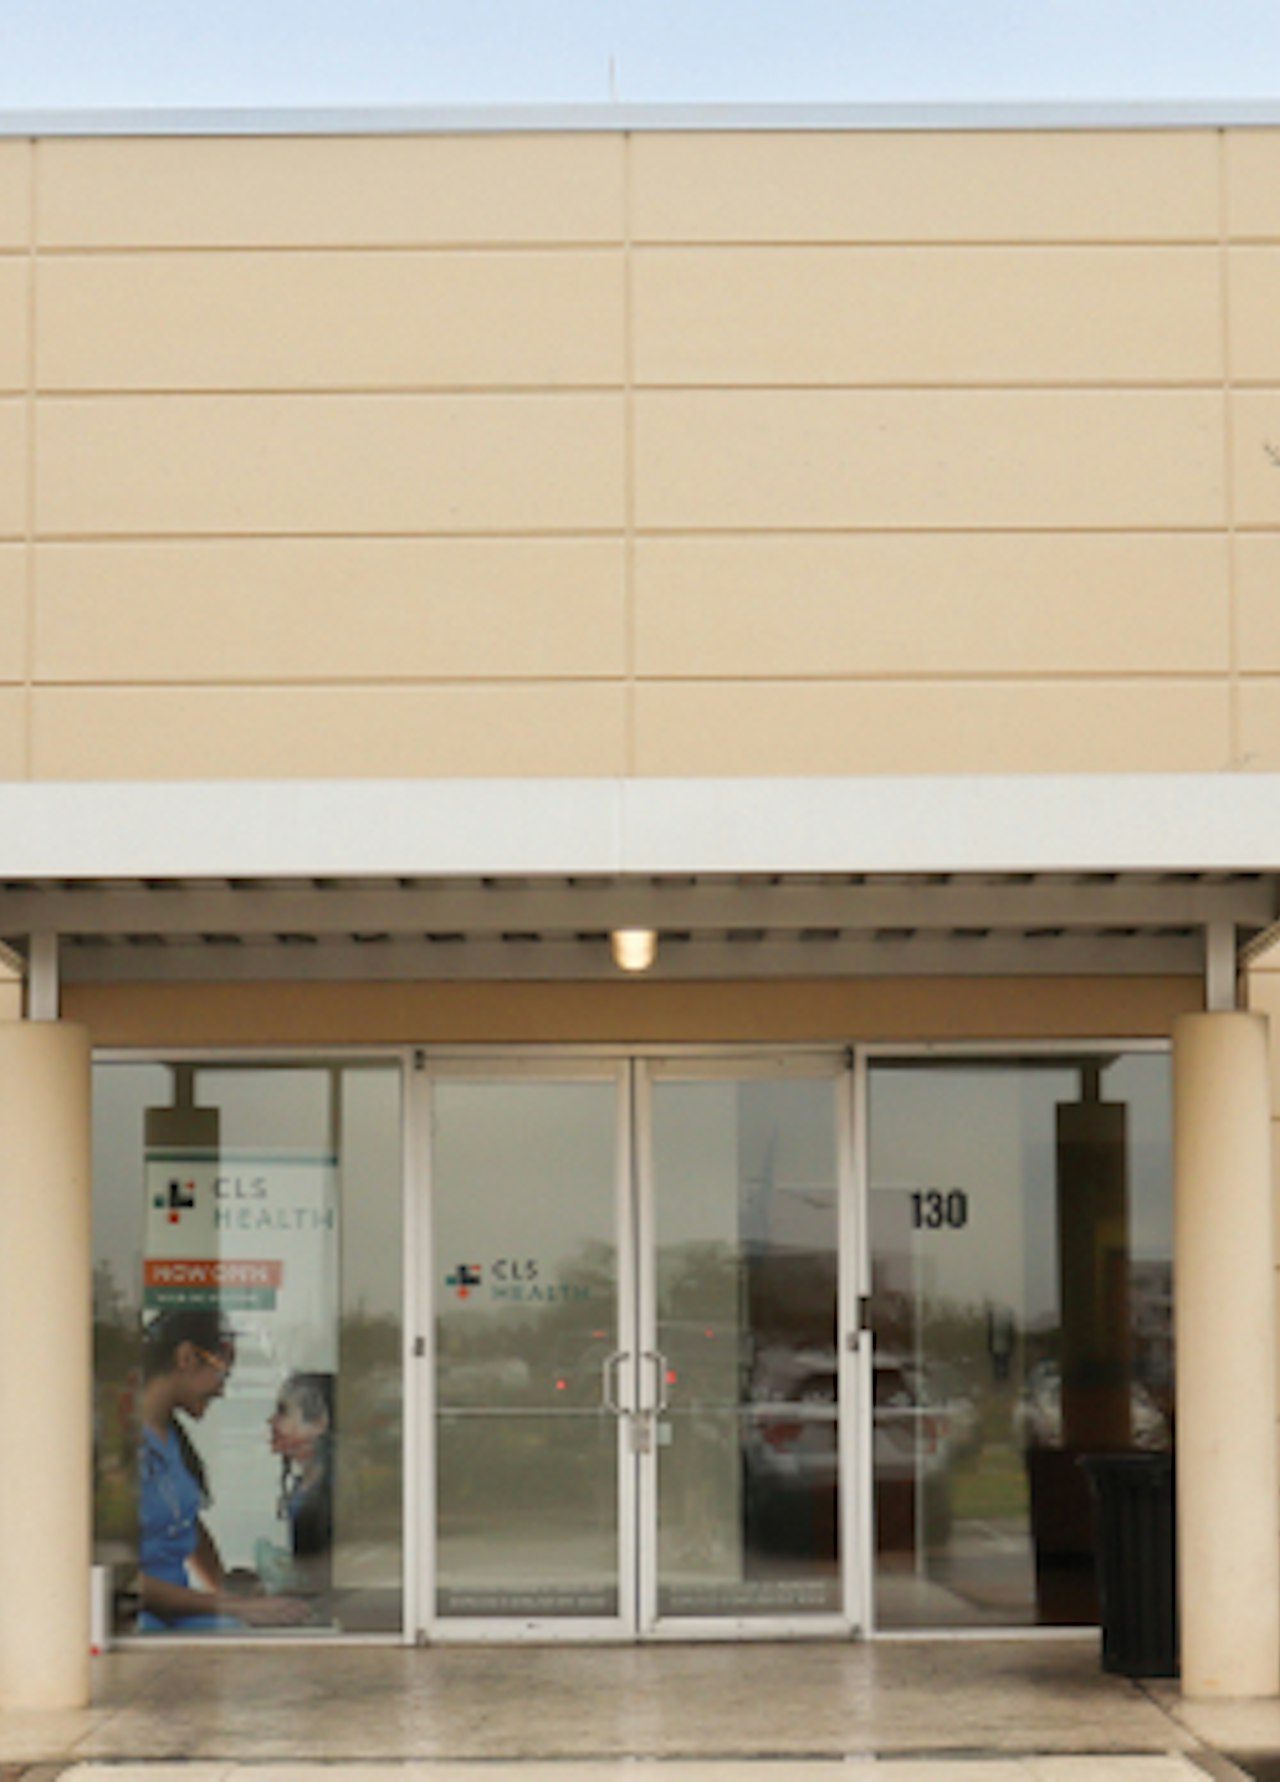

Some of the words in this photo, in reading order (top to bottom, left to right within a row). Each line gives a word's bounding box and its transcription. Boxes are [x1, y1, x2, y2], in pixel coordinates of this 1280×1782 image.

[213, 1177, 268, 1200] CLS
[213, 1207, 334, 1230] HEALTH
[910, 1187, 967, 1229] 130
[491, 1259, 539, 1281] CLS
[492, 1285, 591, 1302] HEALTH
